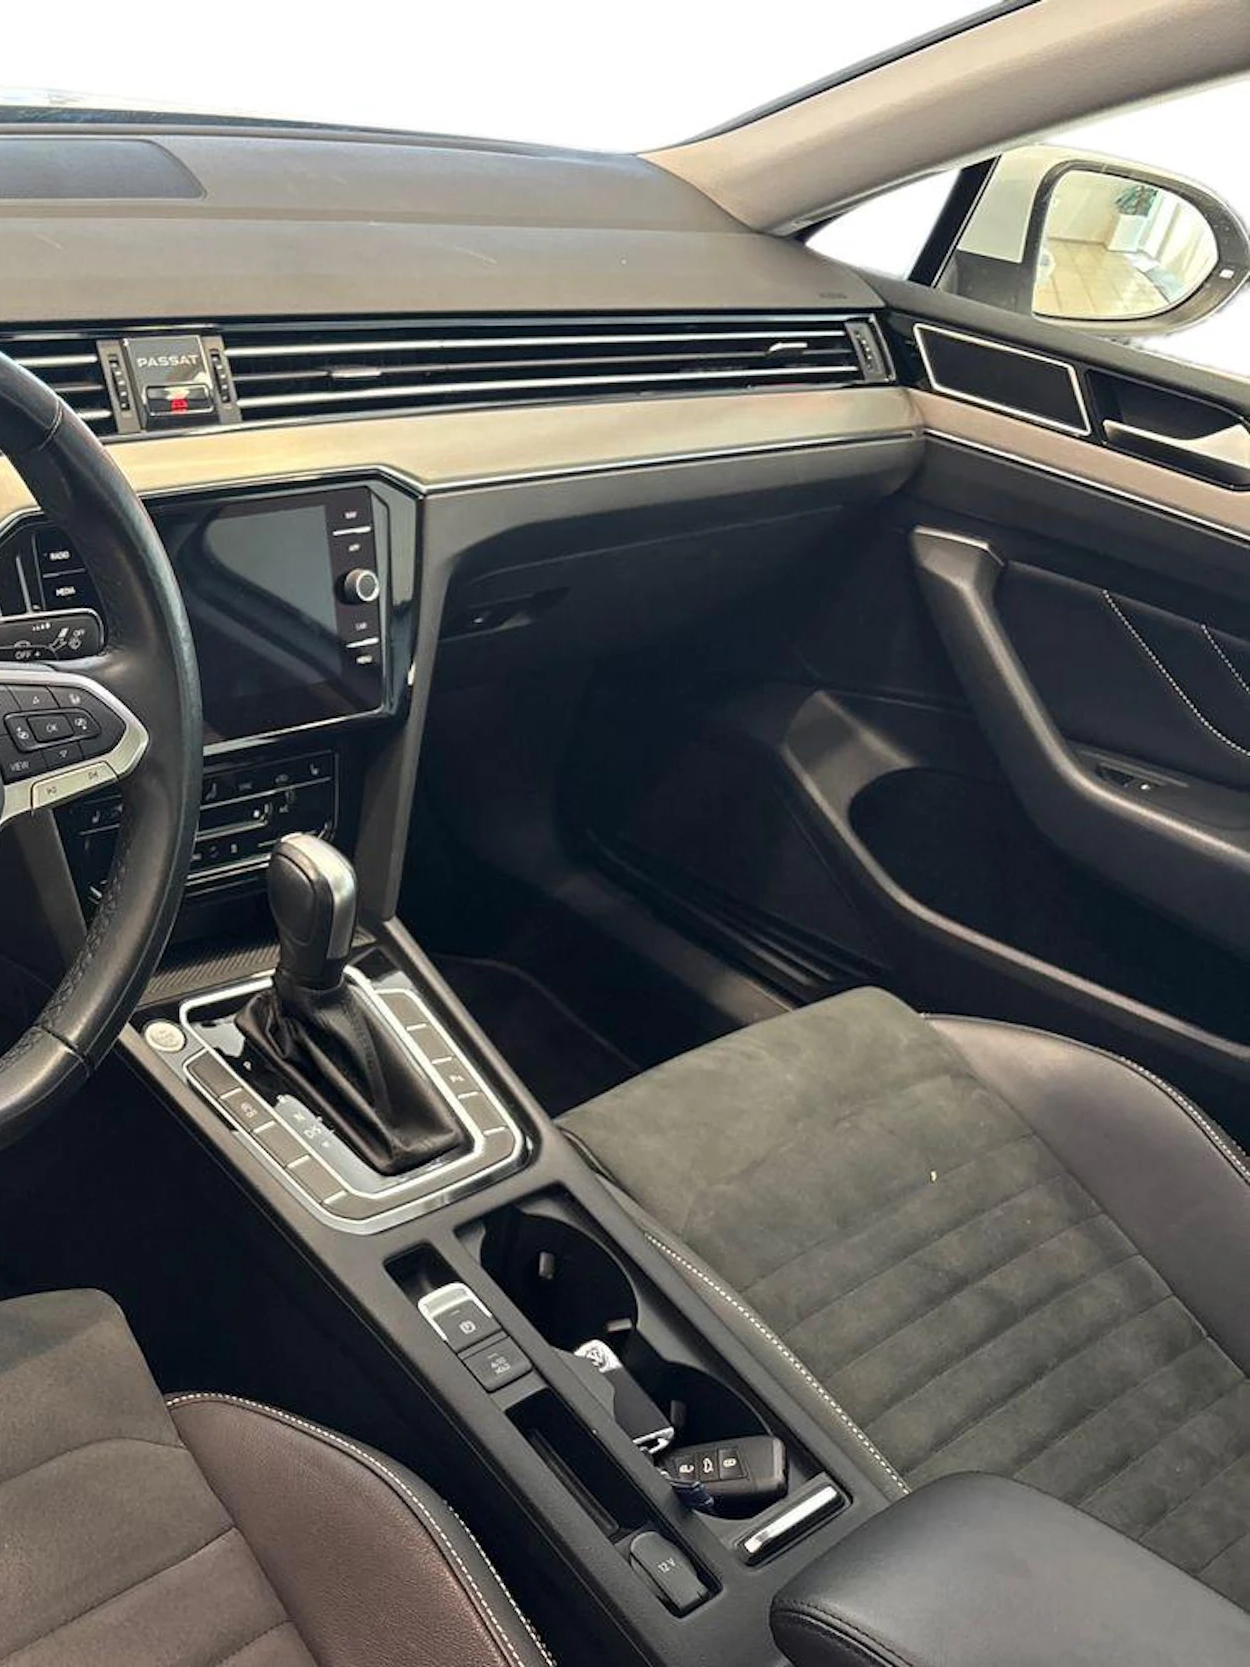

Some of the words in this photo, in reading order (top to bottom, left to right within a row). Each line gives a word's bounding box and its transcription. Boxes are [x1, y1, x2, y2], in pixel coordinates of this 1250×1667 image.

[137, 354, 199, 368] PASSAT
[14, 650, 31, 660] OFF
[45, 723, 59, 733] OK
[10, 761, 31, 772] VIEW
[657, 1561, 670, 1574] 12
